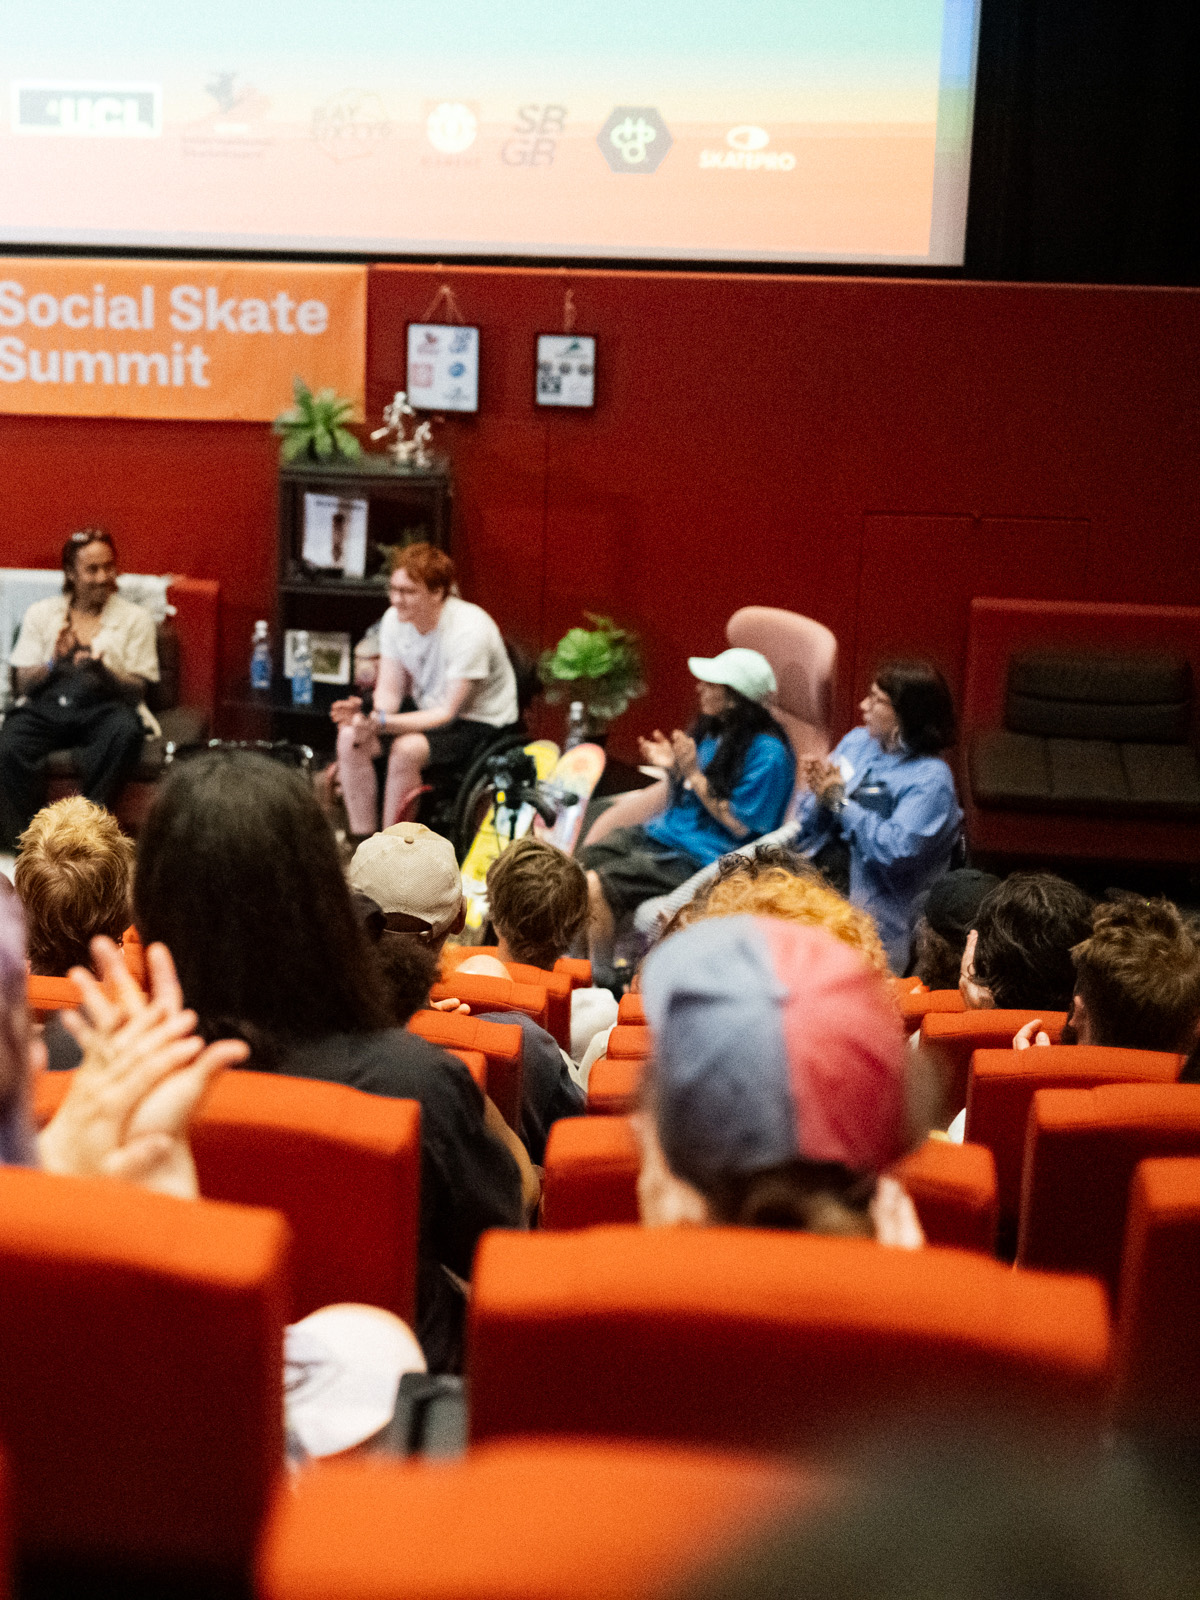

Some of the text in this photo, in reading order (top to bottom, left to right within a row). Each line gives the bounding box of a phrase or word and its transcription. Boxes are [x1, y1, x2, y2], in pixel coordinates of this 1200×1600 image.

[59, 98, 153, 130] UCL
[516, 104, 567, 134] SR
[501, 138, 557, 167] GR
[169, 284, 329, 335] Skate
